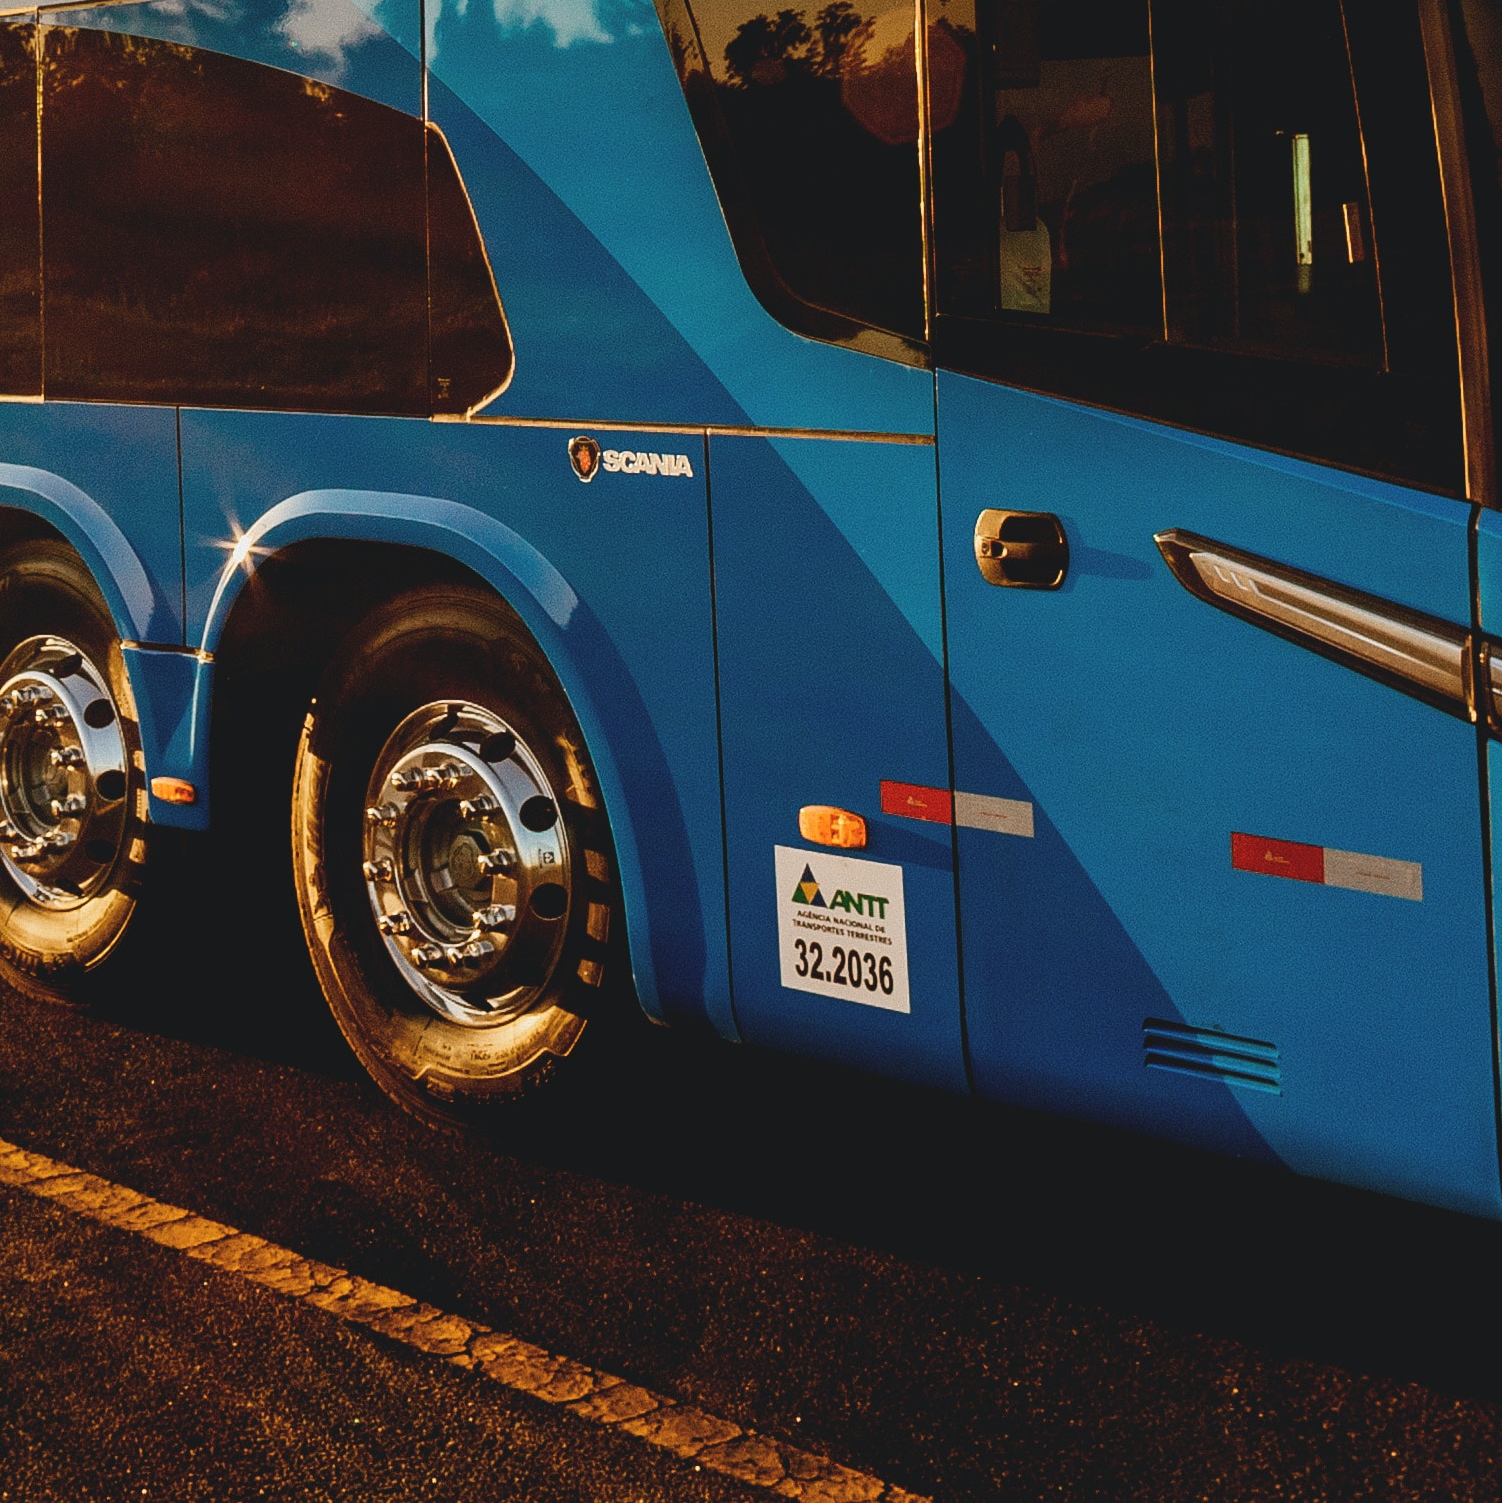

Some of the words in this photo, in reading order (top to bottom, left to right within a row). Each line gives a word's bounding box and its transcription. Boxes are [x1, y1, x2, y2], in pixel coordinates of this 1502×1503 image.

[602, 450, 694, 478] SCANIA
[829, 889, 889, 919] ANTT
[792, 918, 845, 936] TRANSPORTES
[847, 929, 892, 945] TERRESTRES
[833, 917, 873, 931] NACIONAL
[875, 924, 885, 933] DE
[794, 938, 894, 995] 32.2036
